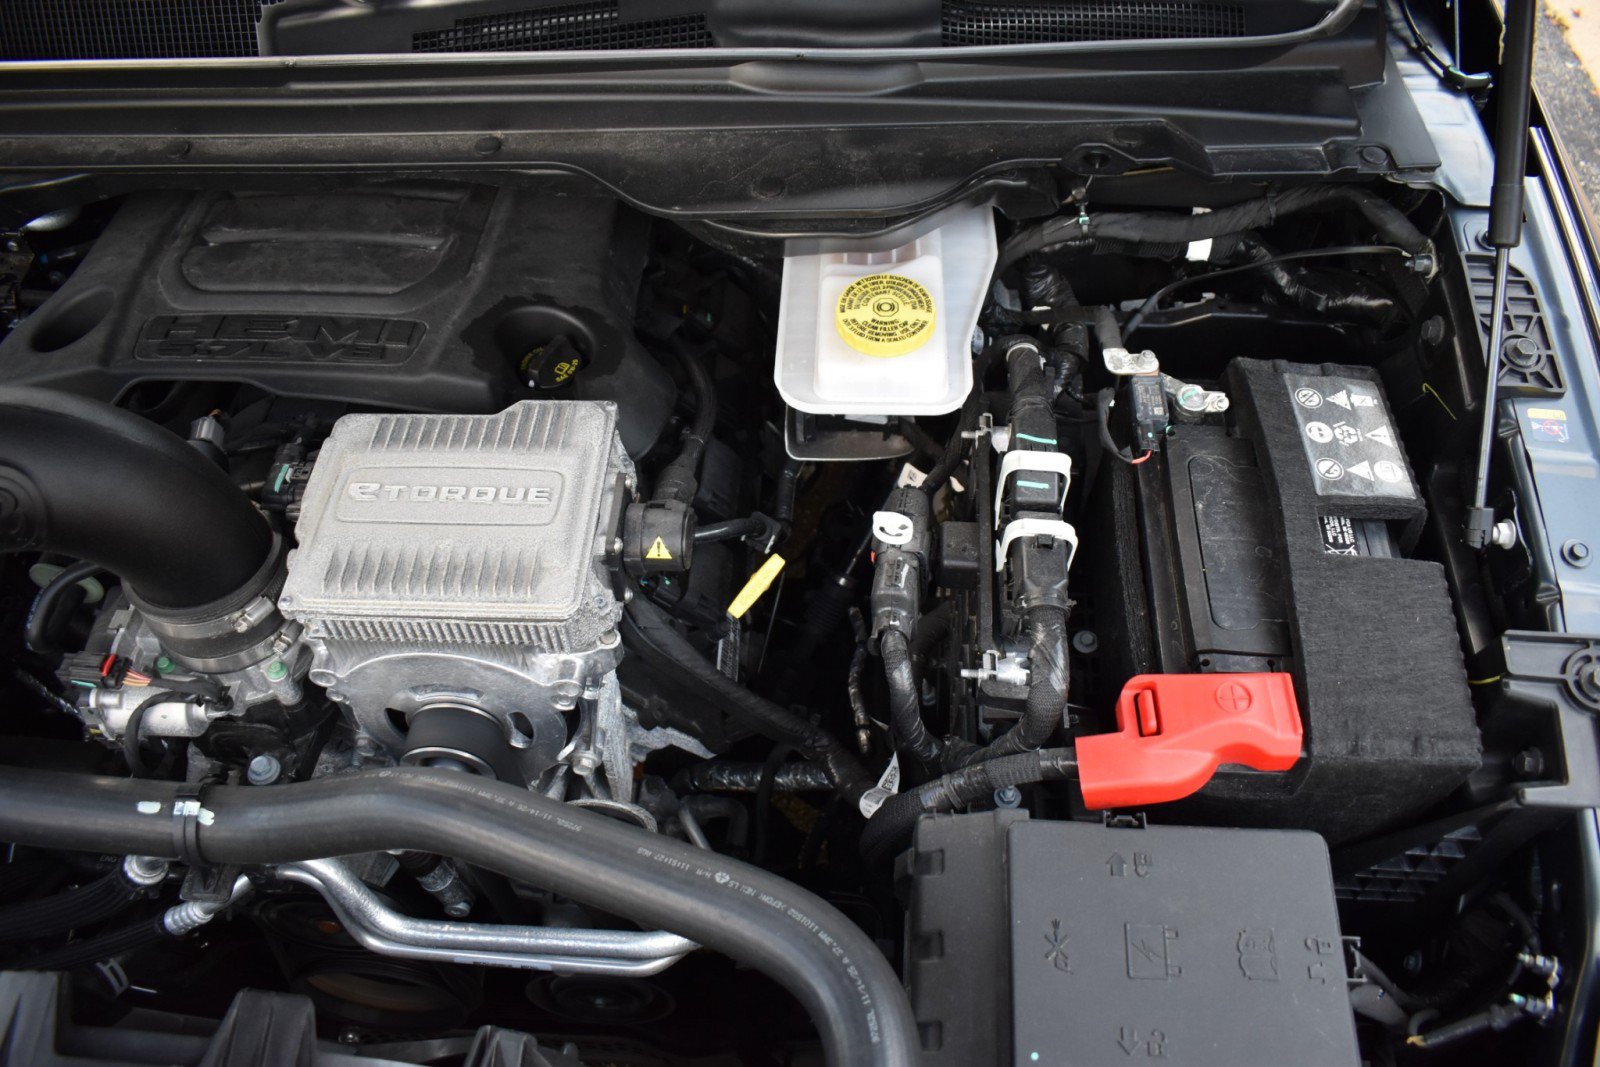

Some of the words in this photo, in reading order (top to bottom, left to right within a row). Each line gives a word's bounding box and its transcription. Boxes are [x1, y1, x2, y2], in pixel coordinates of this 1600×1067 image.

[147, 315, 419, 347] HEMI
[850, 318, 868, 333] BEFORE
[862, 320, 878, 330] CLEAN
